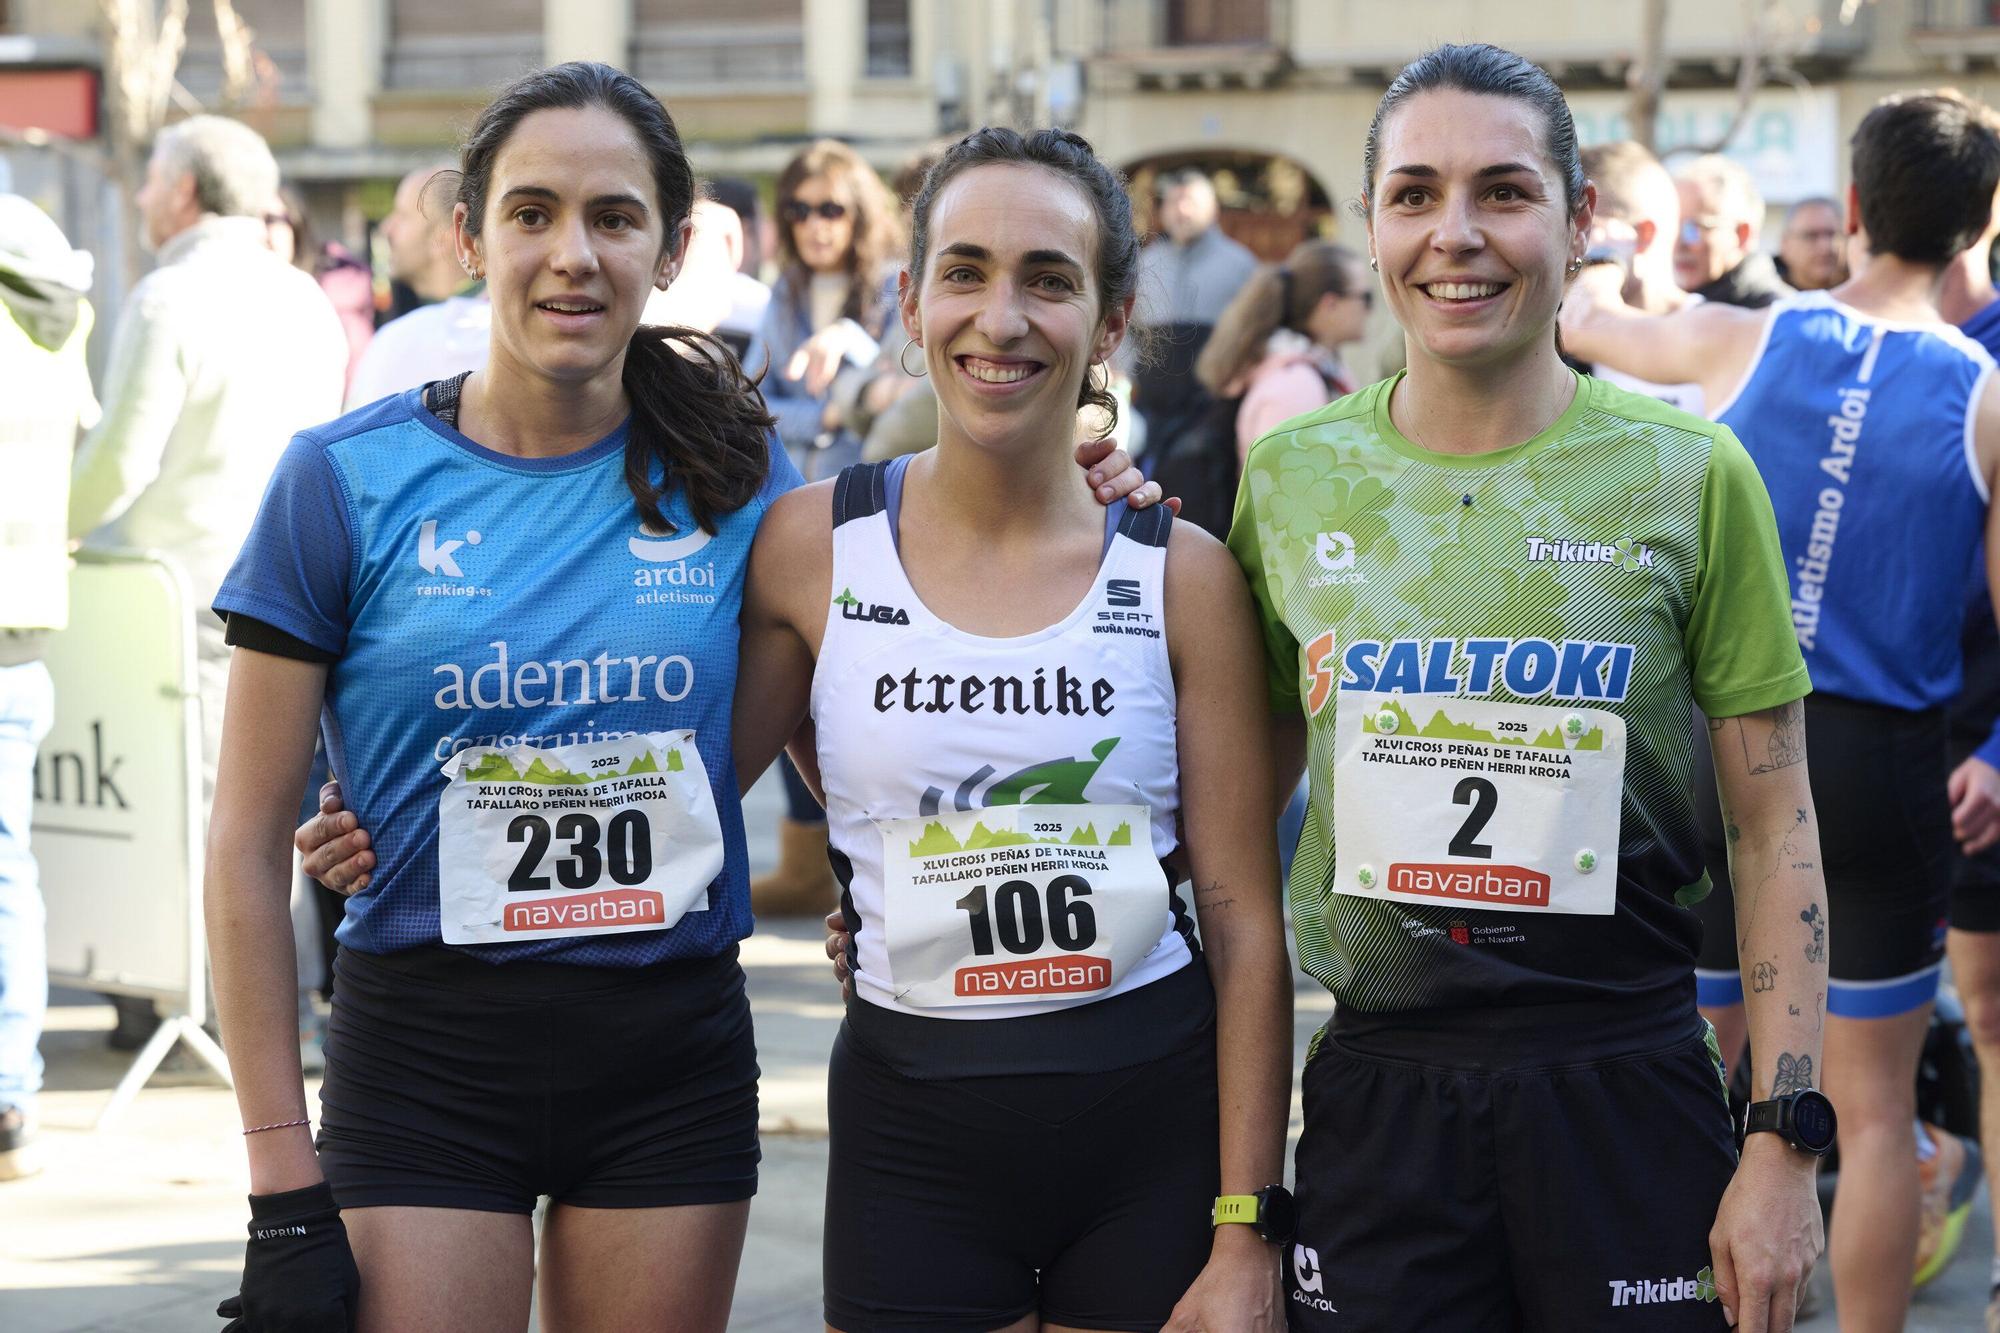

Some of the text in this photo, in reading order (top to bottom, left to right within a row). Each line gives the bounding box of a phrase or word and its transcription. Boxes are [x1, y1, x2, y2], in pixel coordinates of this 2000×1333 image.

[1791, 388, 1871, 650] Atletismo Ardoi
[633, 560, 715, 587] ardoi
[417, 583, 492, 597] ranking.es
[635, 590, 715, 605] atletismo
[842, 600, 910, 626] LUGA
[1097, 611, 1153, 623] SEAT
[1092, 624, 1161, 639] IRUÑA MOTOR
[433, 641, 695, 710] adentro
[1339, 638, 1635, 702] SALTOKI
[873, 665, 1115, 717] etxenike
[1498, 721, 1528, 733] 2025
[33, 717, 130, 810] nk
[591, 756, 620, 769] 2025
[1374, 738, 1572, 765] XLVI CROSS PEÑAS DE TAFALLA
[1361, 751, 1571, 779] TAFALLAKO PEÑEN HERRI KROSA
[467, 790, 667, 810] TAFALLAKO PEÑEN HERRI KROSA
[479, 776, 667, 798] XLVI CROSS PEÑAS DE TAFALLA
[1033, 822, 1062, 832] 2025
[1448, 776, 1499, 859] 2
[506, 808, 653, 892] 230
[923, 847, 1107, 871] XLVI CROSS PEÑAS DE TAFALLA
[911, 859, 1110, 886] TAFALLAKO PEÑEN HERRI KROSA
[1396, 867, 1542, 899] navarban
[513, 892, 656, 927] navarban
[955, 873, 1097, 956] 106
[1472, 925, 1516, 935] Gobierno
[1488, 934, 1525, 944] Navarra
[963, 962, 1104, 992] navarban
[257, 1225, 307, 1240] KIPRUN
[1292, 1289, 1338, 1313] aural
